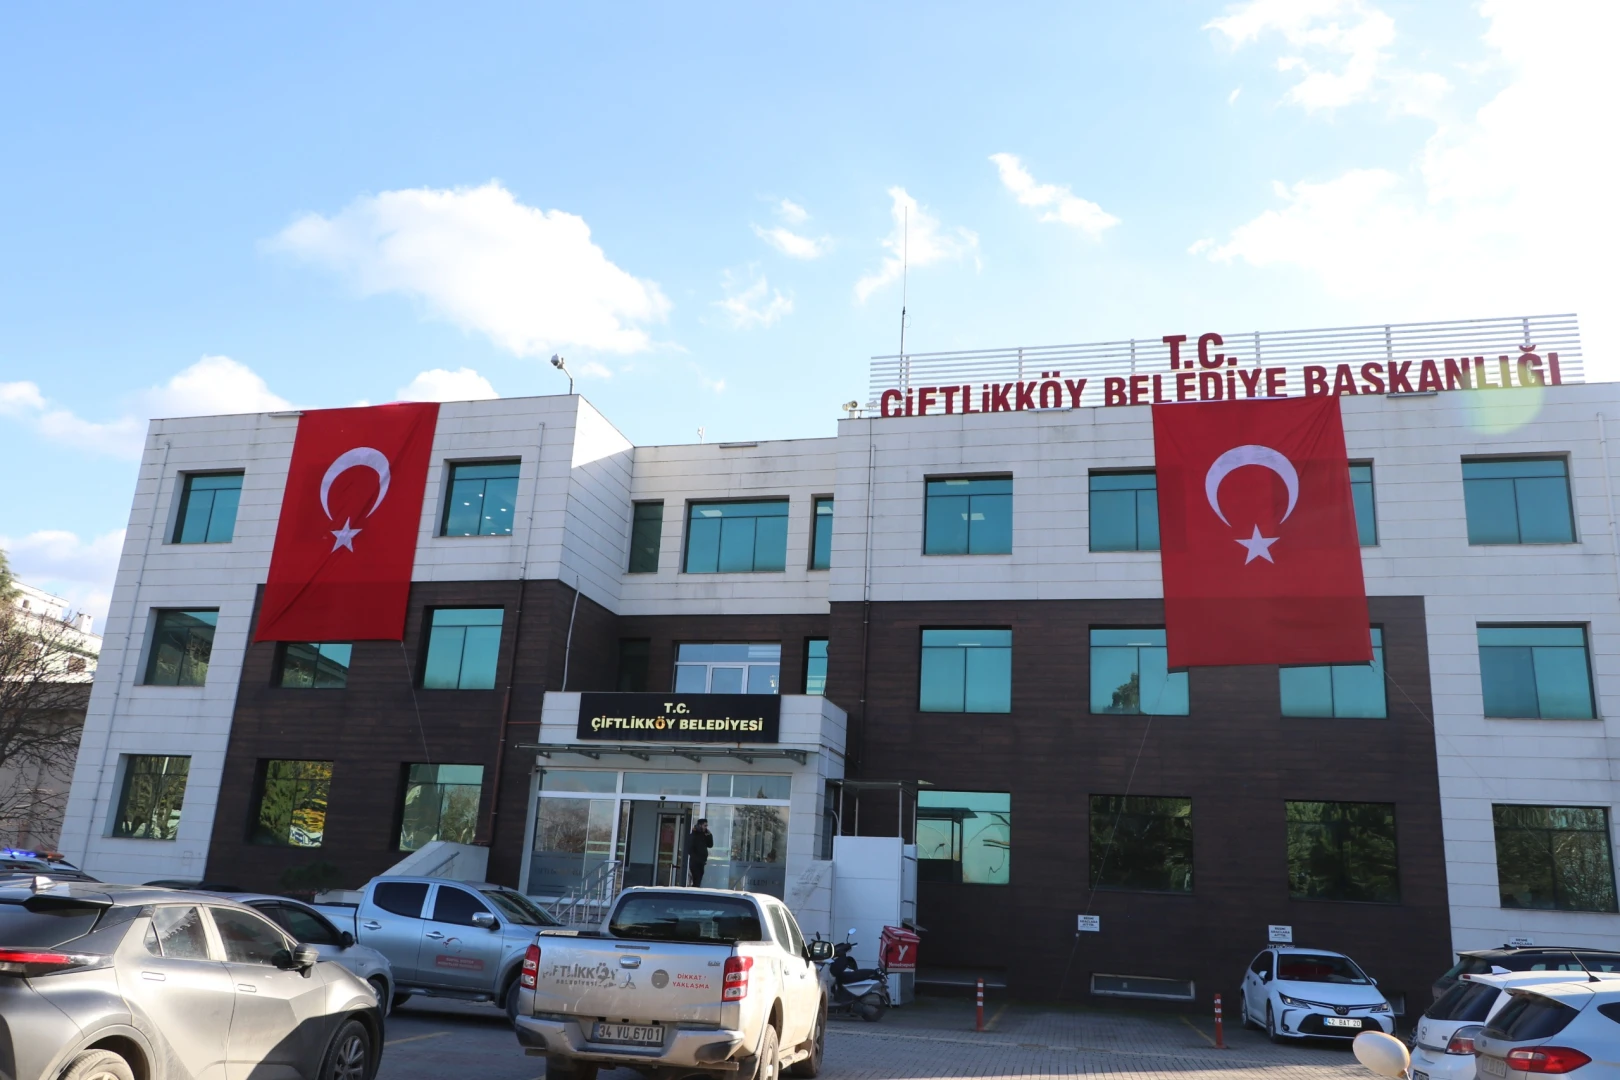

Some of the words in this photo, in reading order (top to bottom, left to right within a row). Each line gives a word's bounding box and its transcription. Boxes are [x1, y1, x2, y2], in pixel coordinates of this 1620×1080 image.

[1162, 332, 1237, 370] T.C.
[664, 702, 690, 714] T.C.
[591, 715, 676, 732] ÇİFTLİKKÖY
[679, 716, 764, 731] BELEDİYESİ
[898, 944, 908, 962] Y
[672, 981, 710, 989] YAKLAŞMA
[677, 973, 701, 981] DİKKAT
[599, 1025, 612, 1038] 34
[616, 1026, 630, 1039] VU
[633, 1027, 660, 1041] 6701
